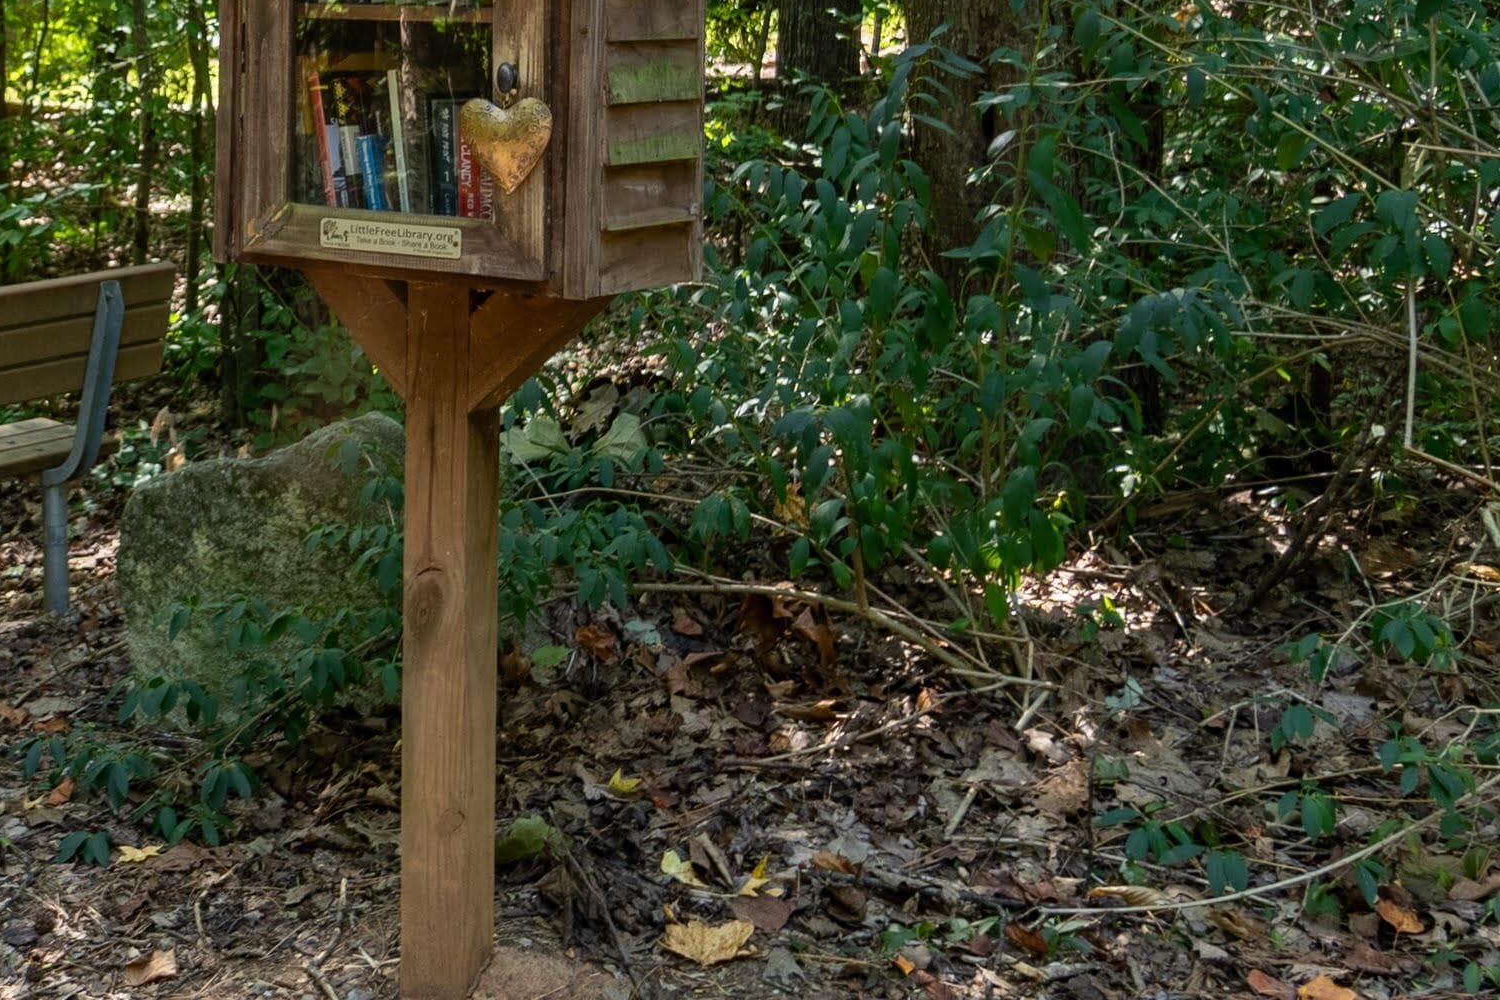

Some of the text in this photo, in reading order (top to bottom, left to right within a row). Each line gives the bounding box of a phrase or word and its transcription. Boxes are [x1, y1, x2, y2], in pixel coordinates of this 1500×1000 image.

[460, 145, 472, 188] CLANCY
[480, 167, 493, 220] ALDACC
[350, 225, 454, 243] LittleFreeLibrary.org
[356, 236, 372, 245] Take
[379, 238, 395, 246] Book
[402, 239, 422, 248] Share
[430, 241, 447, 249] Book
